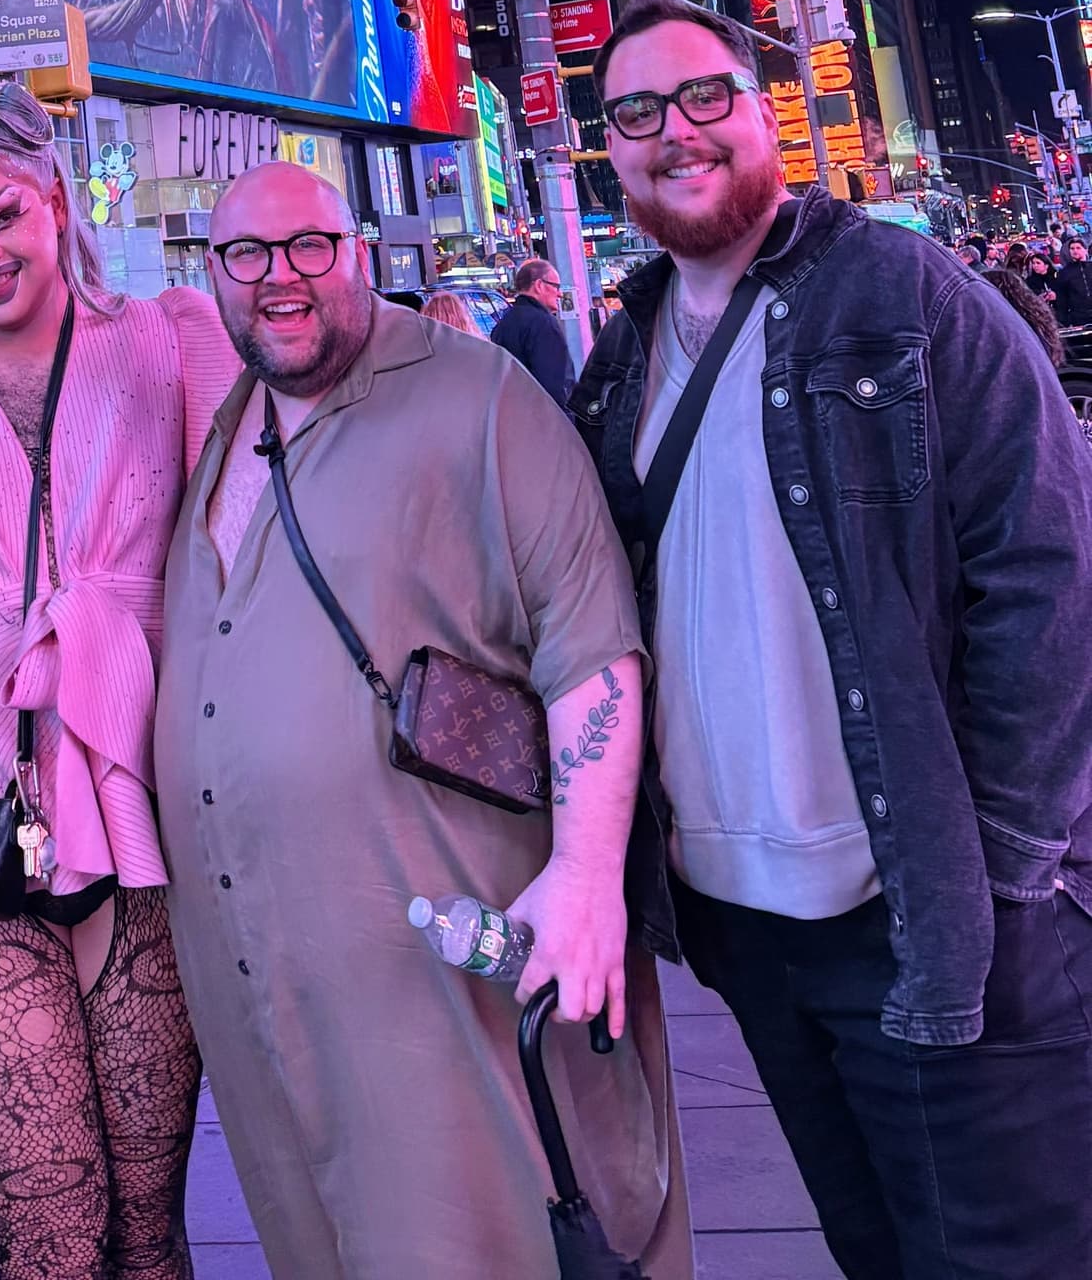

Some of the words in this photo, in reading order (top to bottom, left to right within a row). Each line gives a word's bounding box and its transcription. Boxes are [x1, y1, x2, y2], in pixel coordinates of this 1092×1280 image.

[561, 4, 594, 18] STANDING
[0, 14, 47, 29] Square
[28, 28, 61, 40] Plaza
[770, 80, 819, 184] BLAKE
[179, 104, 280, 180] FOREVER
